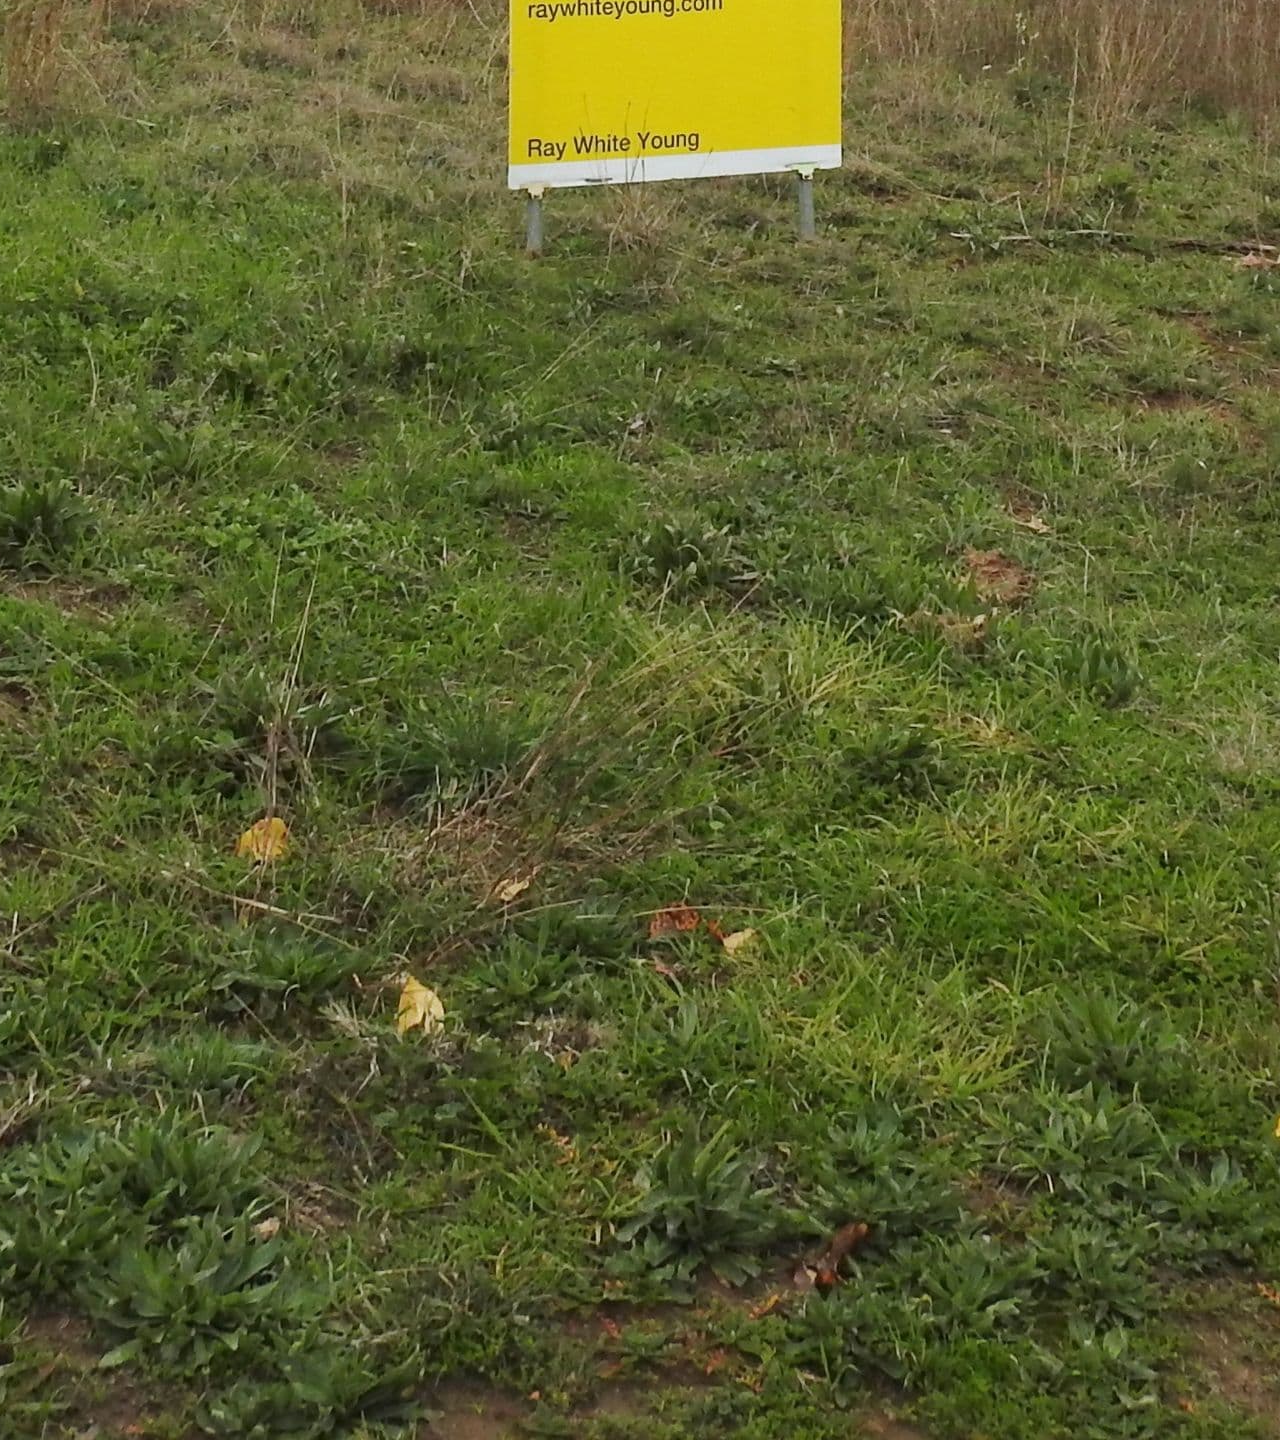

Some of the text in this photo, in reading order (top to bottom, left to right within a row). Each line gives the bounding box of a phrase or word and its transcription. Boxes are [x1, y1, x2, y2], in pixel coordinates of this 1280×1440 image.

[528, 132, 700, 160] Ray White Young
